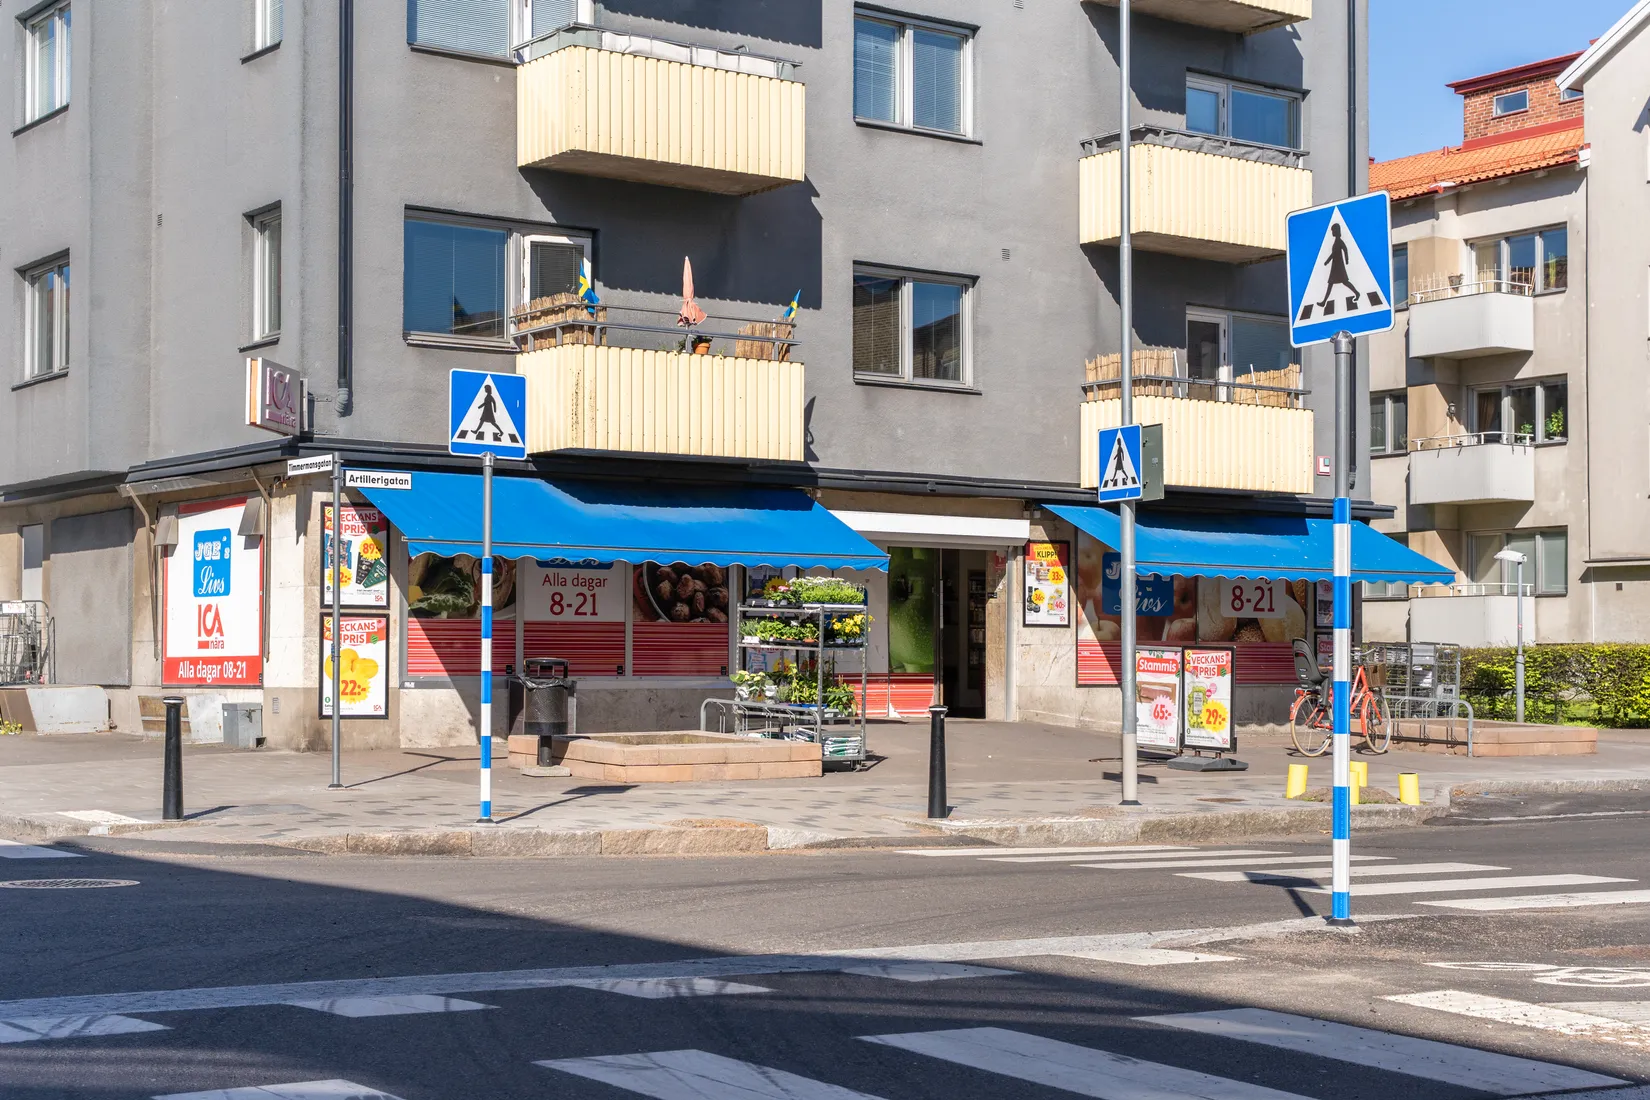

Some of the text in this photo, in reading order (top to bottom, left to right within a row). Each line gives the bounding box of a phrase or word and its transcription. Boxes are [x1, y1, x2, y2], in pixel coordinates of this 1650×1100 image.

[266, 367, 296, 414] ICA
[288, 459, 332, 471] Timmermansgatan
[348, 474, 409, 487] Artillerigatan
[340, 512, 377, 522] ECKANS
[344, 524, 366, 534] PRIS
[1036, 550, 1057, 559] KLIPP!
[197, 565, 225, 595] Livs
[542, 572, 608, 591] Alla dagar
[549, 591, 599, 616] 8-21
[1231, 585, 1275, 613] 8-21
[197, 603, 225, 638] ICA
[340, 622, 376, 632] ECKANS
[210, 638, 225, 650] nära
[343, 634, 365, 643] PRIS
[1139, 659, 1177, 672] Stammis
[1191, 654, 1225, 665] VECKANS
[178, 661, 194, 679] Alla
[197, 660, 221, 683] dagar
[223, 660, 247, 678] 08-21
[1199, 666, 1216, 676] PRIS
[340, 679, 367, 696] 22:-
[1153, 704, 1172, 720] 65:-
[1205, 708, 1226, 725] 29:-
